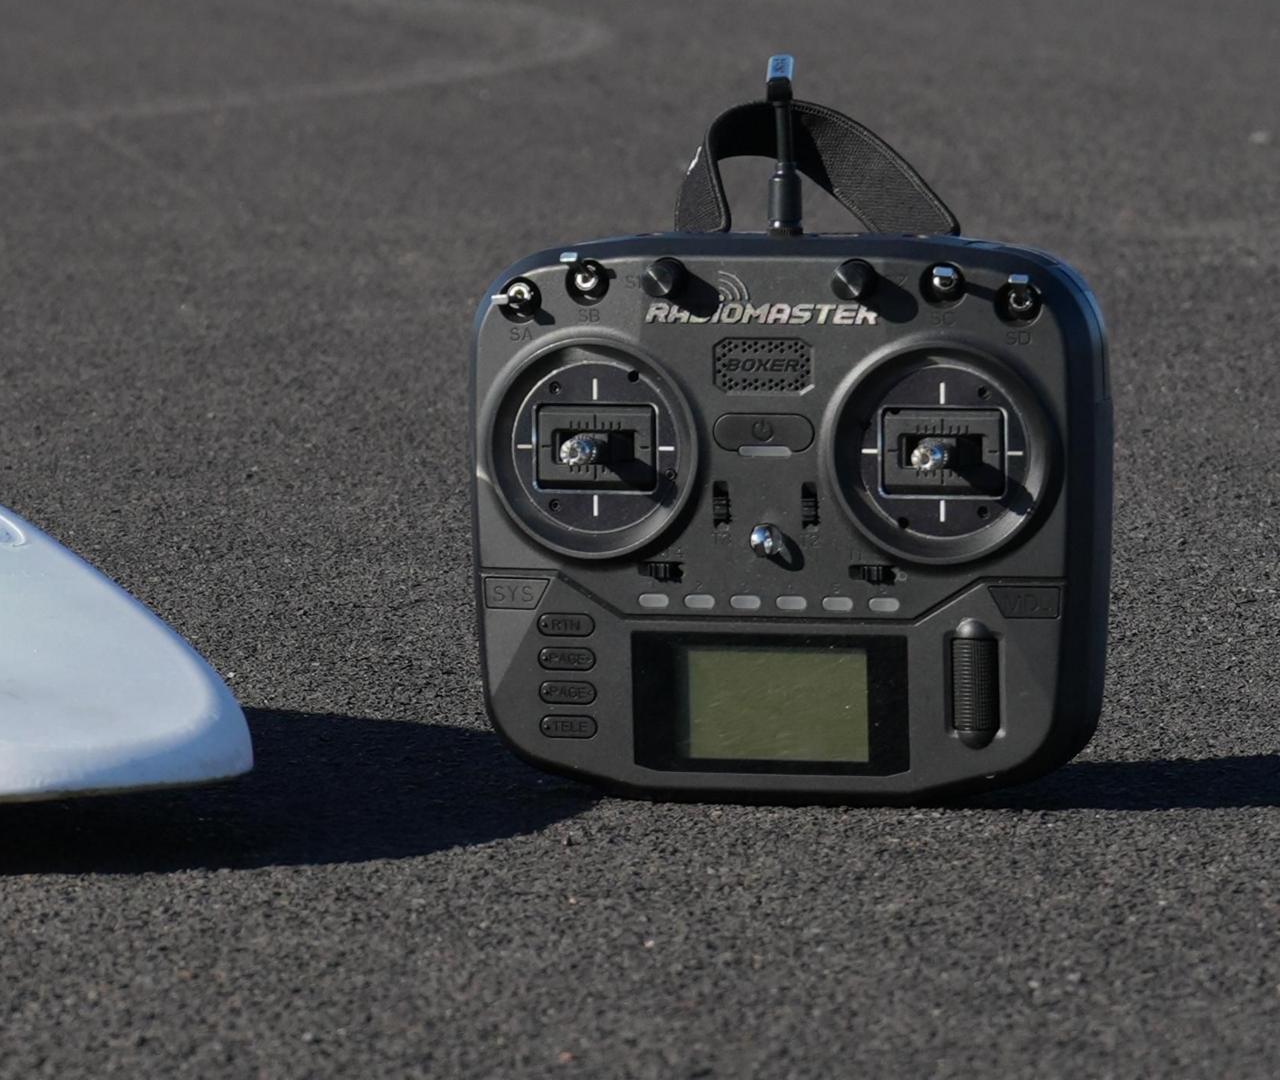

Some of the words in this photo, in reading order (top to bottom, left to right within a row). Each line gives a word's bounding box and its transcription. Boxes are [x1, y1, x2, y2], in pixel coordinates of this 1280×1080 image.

[577, 308, 601, 323] SB
[508, 327, 534, 342] SA
[724, 356, 802, 374] BOXER
[492, 585, 535, 603] SYS
[551, 619, 581, 632] RTN
[552, 720, 589, 733] TELE
